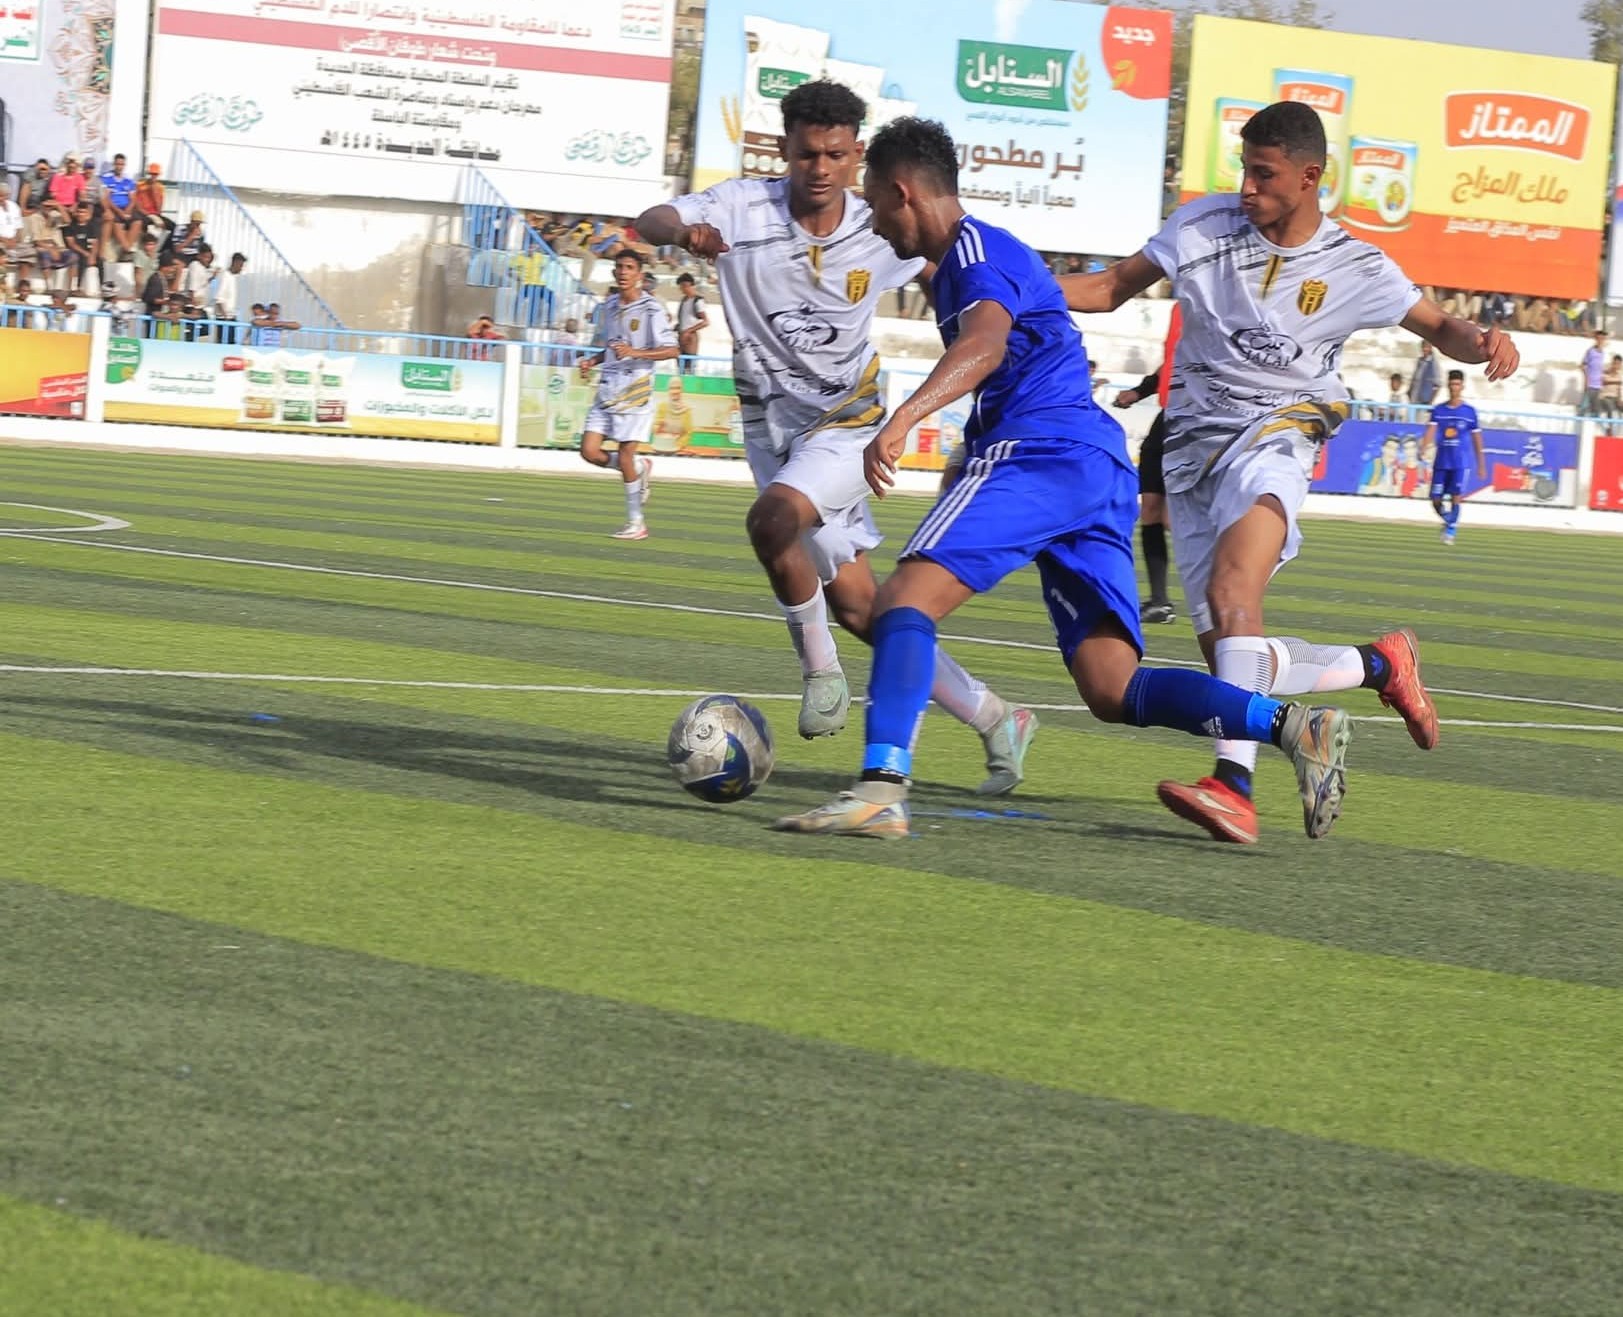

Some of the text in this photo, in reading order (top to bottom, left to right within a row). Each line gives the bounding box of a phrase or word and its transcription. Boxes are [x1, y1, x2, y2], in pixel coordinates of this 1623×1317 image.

[1112, 25, 1156, 46] جديد
[964, 51, 1064, 93] السنابل
[1458, 100, 1576, 146] الممتاز
[1450, 165, 1569, 204] ملك المزاج
